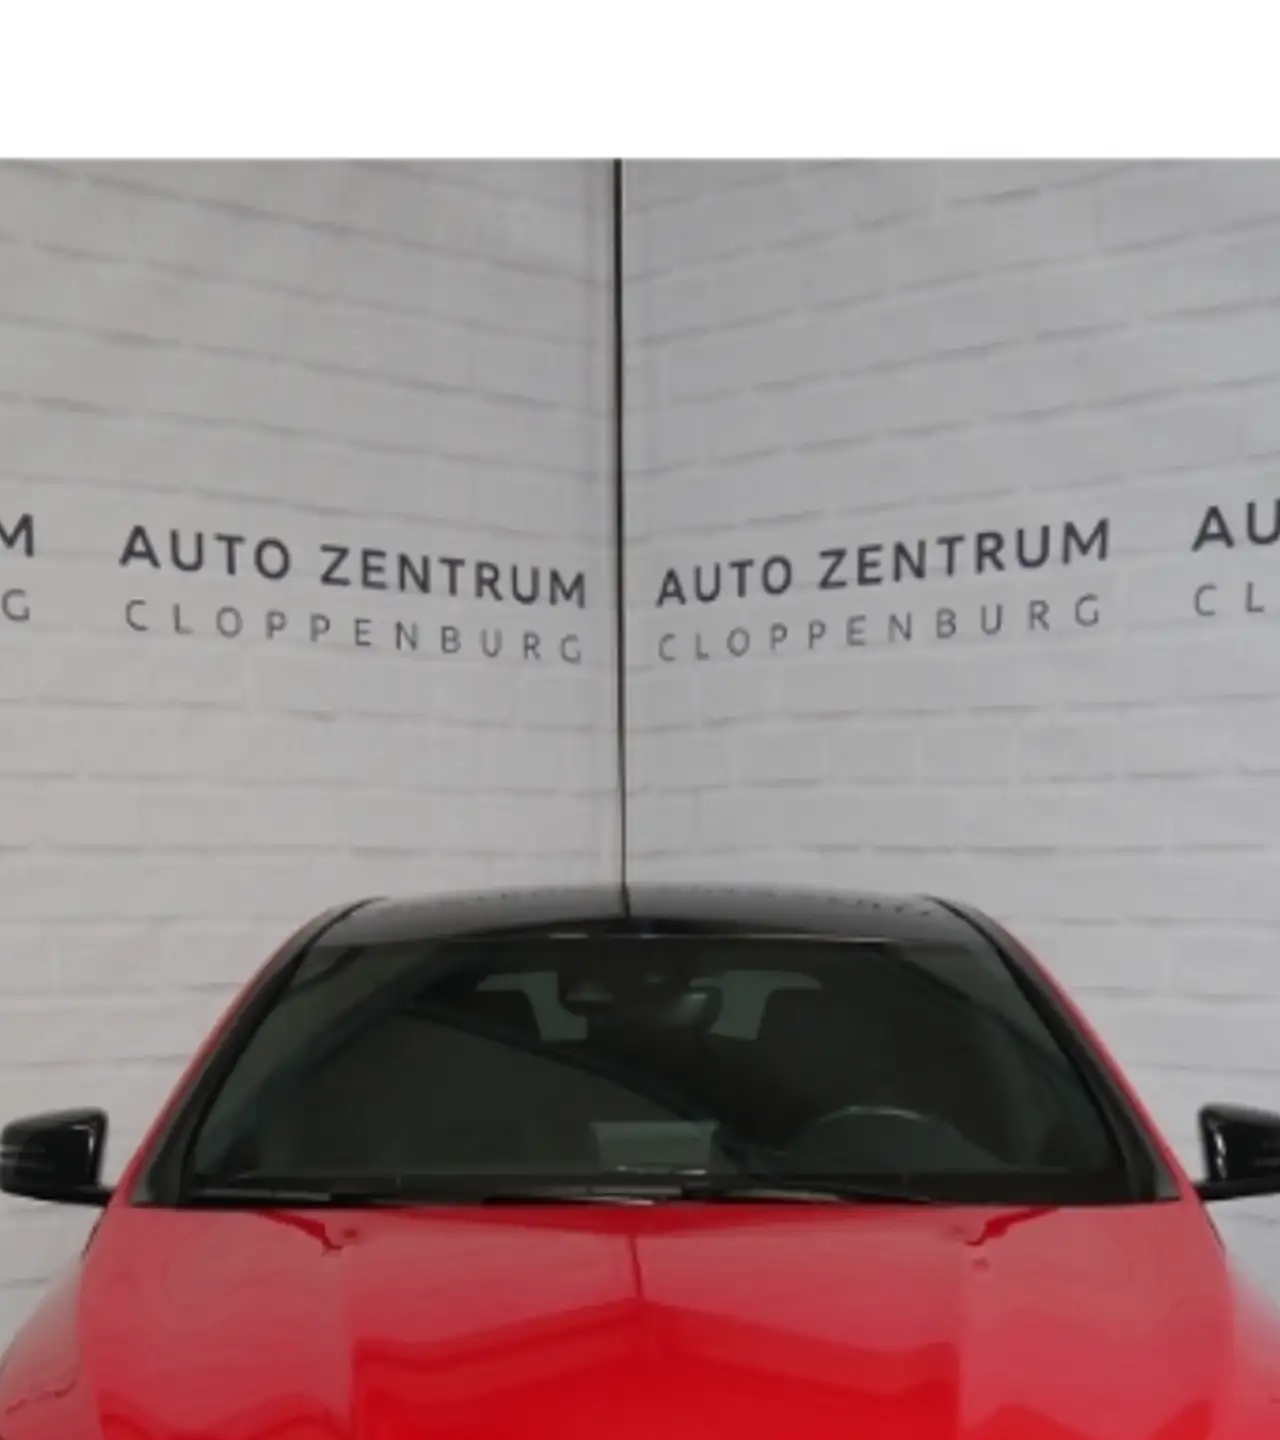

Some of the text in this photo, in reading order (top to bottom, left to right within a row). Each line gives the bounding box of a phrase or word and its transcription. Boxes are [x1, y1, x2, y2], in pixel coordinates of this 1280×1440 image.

[117, 524, 588, 611] AUTO ZENTRUM
[654, 516, 1112, 609] AUTO ZENTRUM
[124, 598, 583, 666] CLOPPENBURG
[658, 592, 1101, 663] CLOPPENBURG
